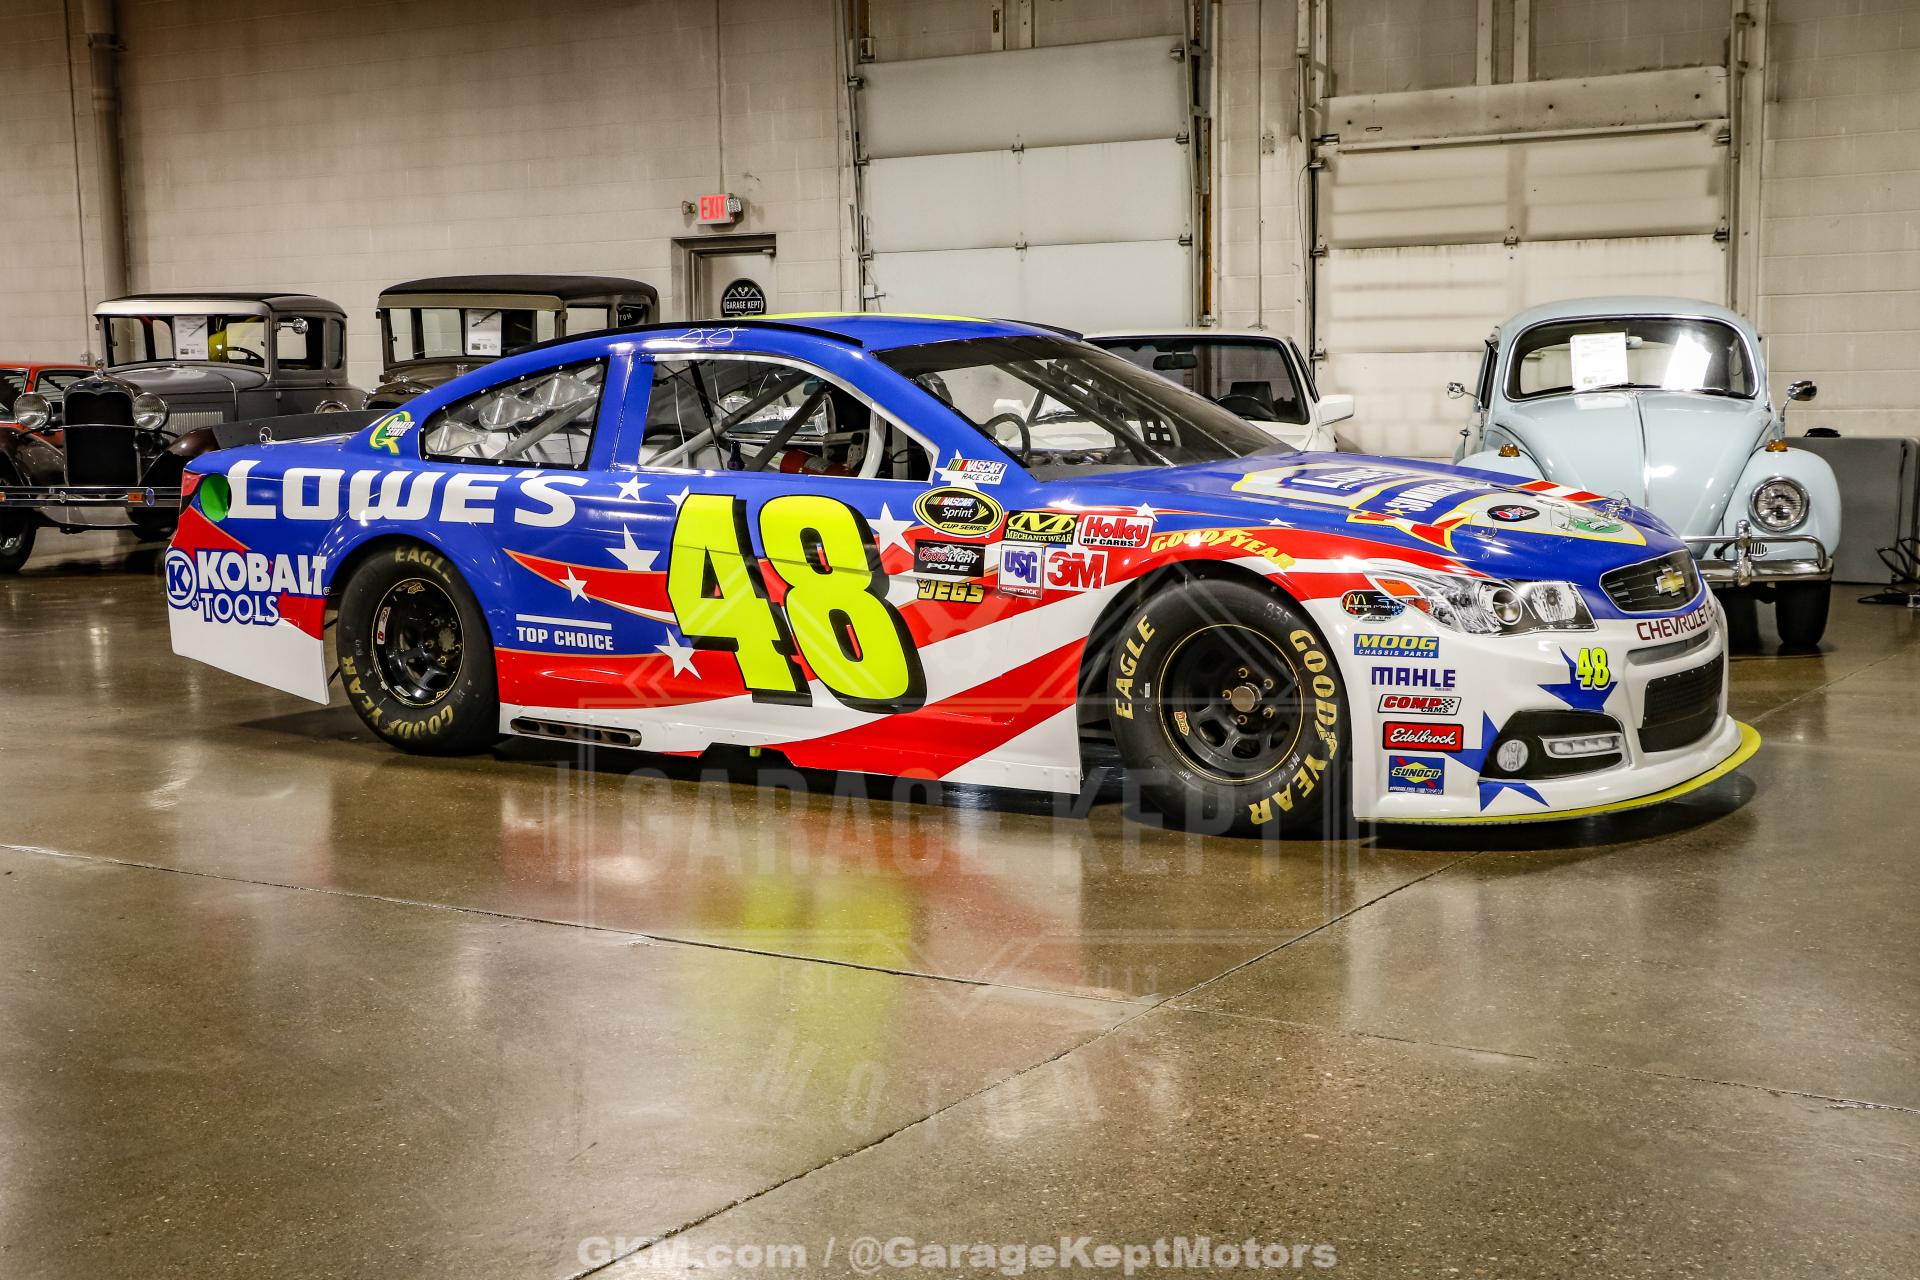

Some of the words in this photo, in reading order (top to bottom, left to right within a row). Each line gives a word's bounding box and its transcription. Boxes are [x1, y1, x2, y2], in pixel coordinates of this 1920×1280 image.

[700, 194, 725, 220] EXIT
[726, 300, 746, 310] GARAGE
[747, 300, 761, 309] KEPT
[964, 460, 1003, 474] NASCAR
[961, 473, 980, 481] RACE
[982, 474, 1000, 482] CAR
[227, 460, 589, 528] LOWE'S
[941, 497, 977, 507] NASCAR
[941, 507, 974, 519] Sprint
[960, 523, 989, 531] SERIES
[1004, 529, 1048, 542] MECHANIX
[1048, 533, 1072, 543] WEAR
[1084, 517, 1150, 547] Holley
[1099, 538, 1134, 547] CARBS
[1150, 529, 1297, 570] GOODYEAR
[926, 562, 971, 572] POLE
[948, 552, 980, 564] LIGHT
[1004, 550, 1038, 584] USG
[197, 552, 328, 595] KOBALT
[1047, 551, 1105, 590] 3M
[200, 592, 280, 622] TOOLS
[667, 494, 927, 714] 48
[1635, 604, 1709, 641] CHEVROLET
[516, 626, 549, 643] TOP
[553, 629, 615, 651] CHOICE
[1356, 634, 1438, 651] MOOG
[1115, 614, 1156, 720] EAGLE
[1371, 666, 1456, 687] MAHLE
[1577, 647, 1612, 690] 48
[1383, 696, 1442, 709] COMP
[1389, 728, 1456, 745] Edelbrock
[1393, 768, 1440, 778] SUNOCO
